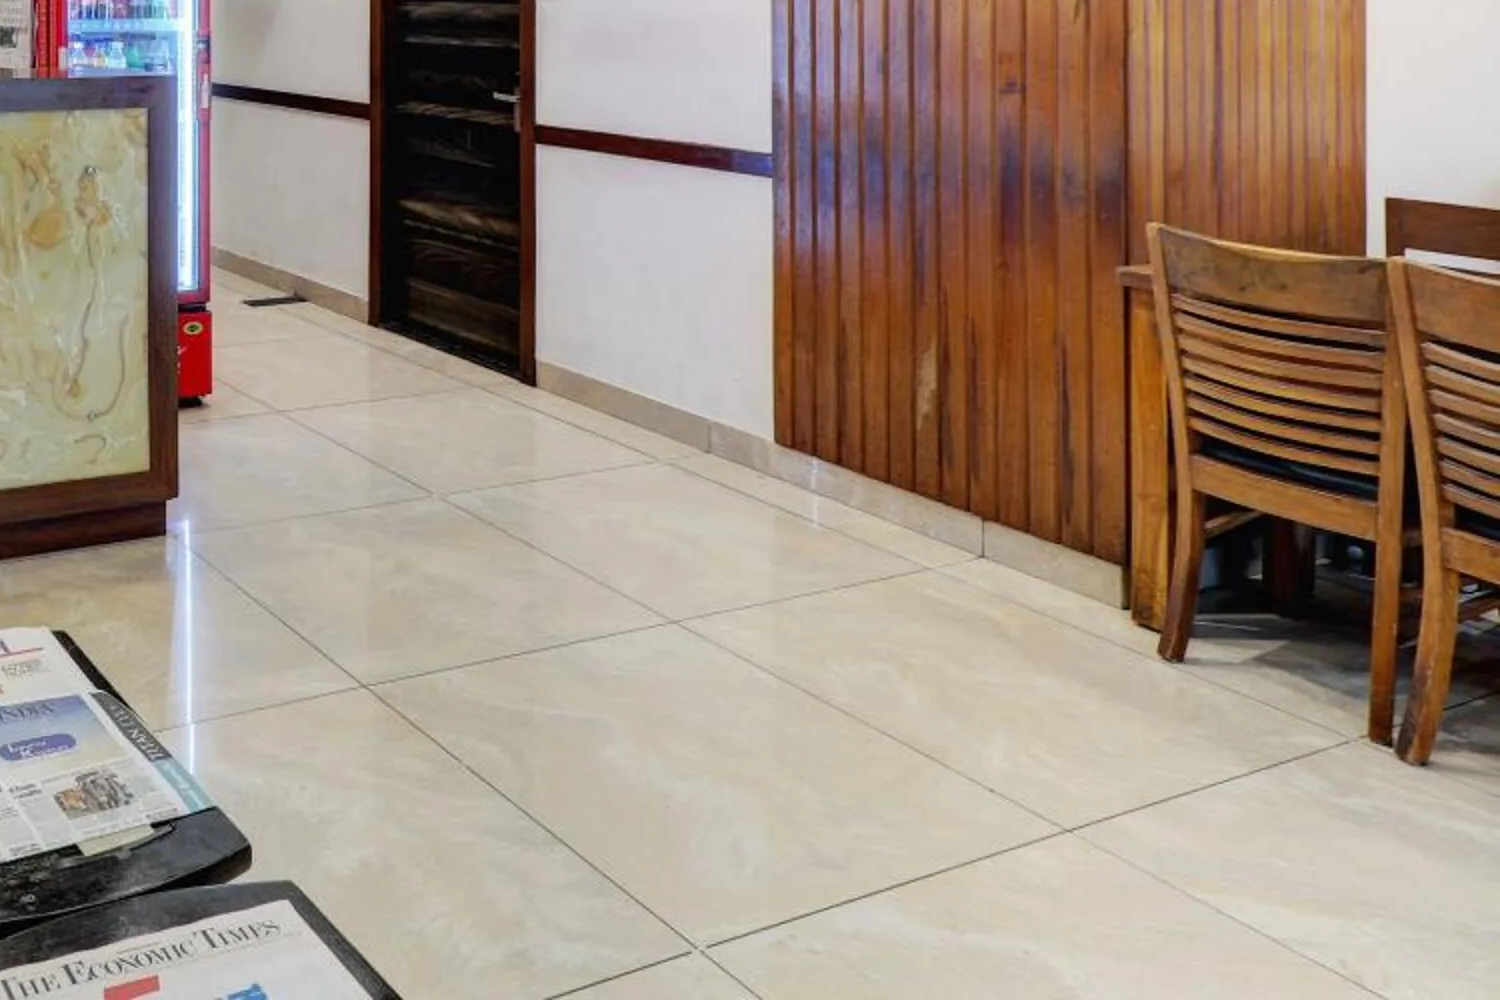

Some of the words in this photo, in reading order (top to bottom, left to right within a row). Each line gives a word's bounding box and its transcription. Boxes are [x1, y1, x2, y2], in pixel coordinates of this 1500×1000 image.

[0, 700, 55, 723] INDIA
[61, 938, 195, 986] ECONOMIC
[193, 919, 281, 949] TIMES
